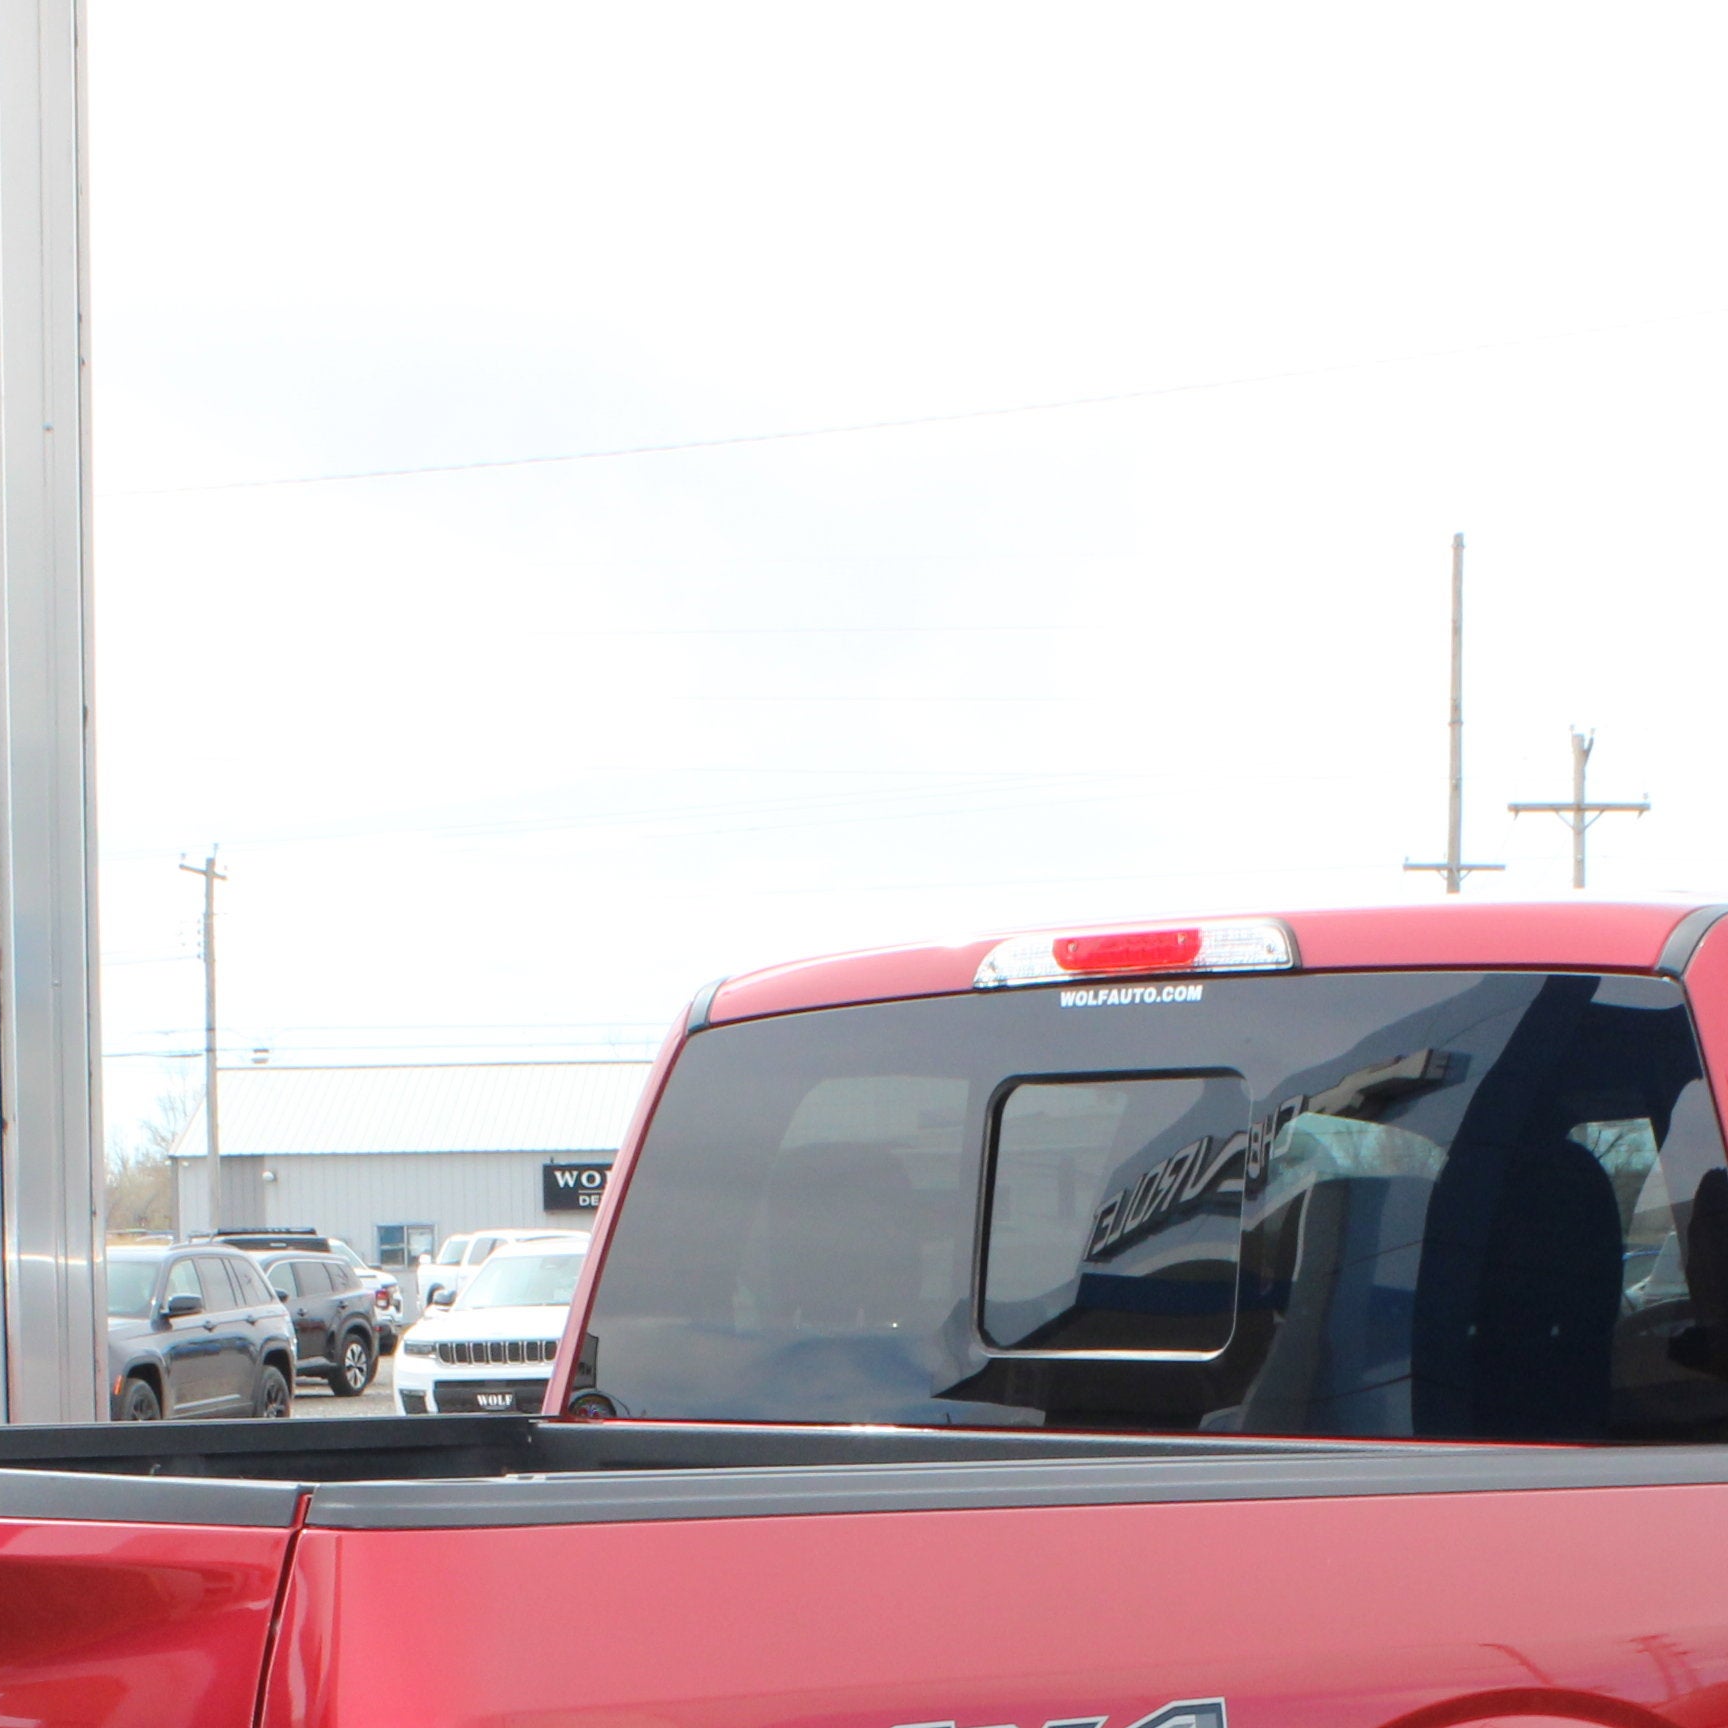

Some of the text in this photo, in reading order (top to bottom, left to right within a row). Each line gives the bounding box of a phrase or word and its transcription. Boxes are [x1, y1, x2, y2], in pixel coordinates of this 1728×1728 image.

[1060, 985, 1203, 1008] WOLFAUTO.COM
[579, 1195, 602, 1206] DE
[477, 1394, 513, 1406] WOLF
